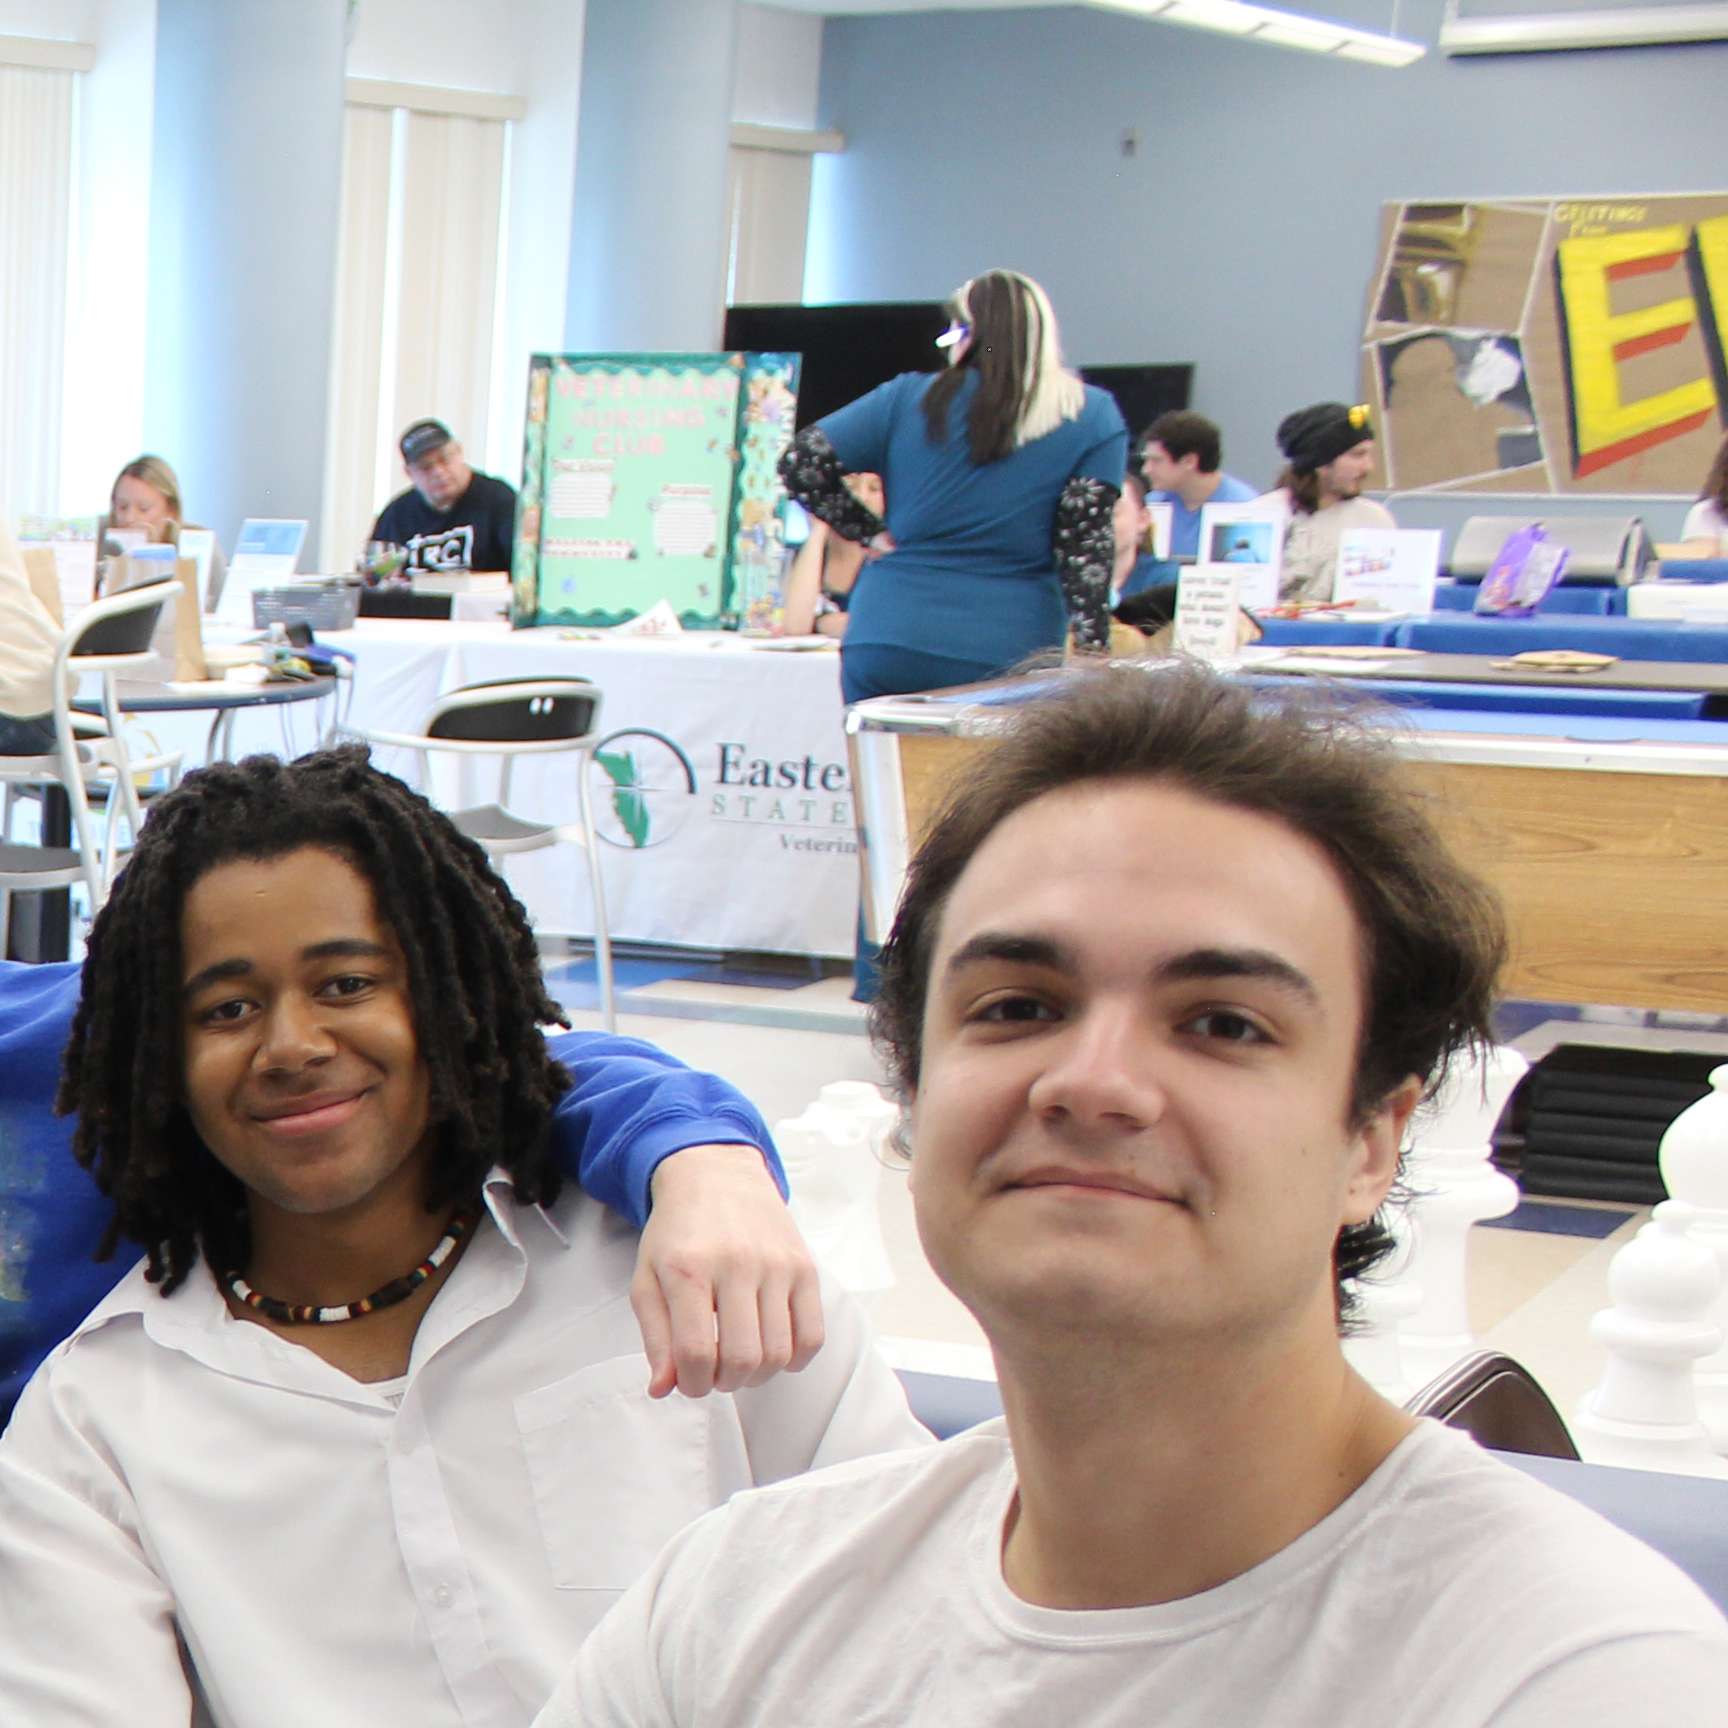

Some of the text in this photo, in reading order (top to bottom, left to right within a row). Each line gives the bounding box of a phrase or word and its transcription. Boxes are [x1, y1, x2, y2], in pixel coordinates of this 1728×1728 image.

[555, 376, 740, 400] VETERINARY
[572, 405, 706, 430] NURSING
[593, 432, 665, 457] CLUB
[713, 741, 854, 792] Easte
[711, 794, 849, 823] STATE
